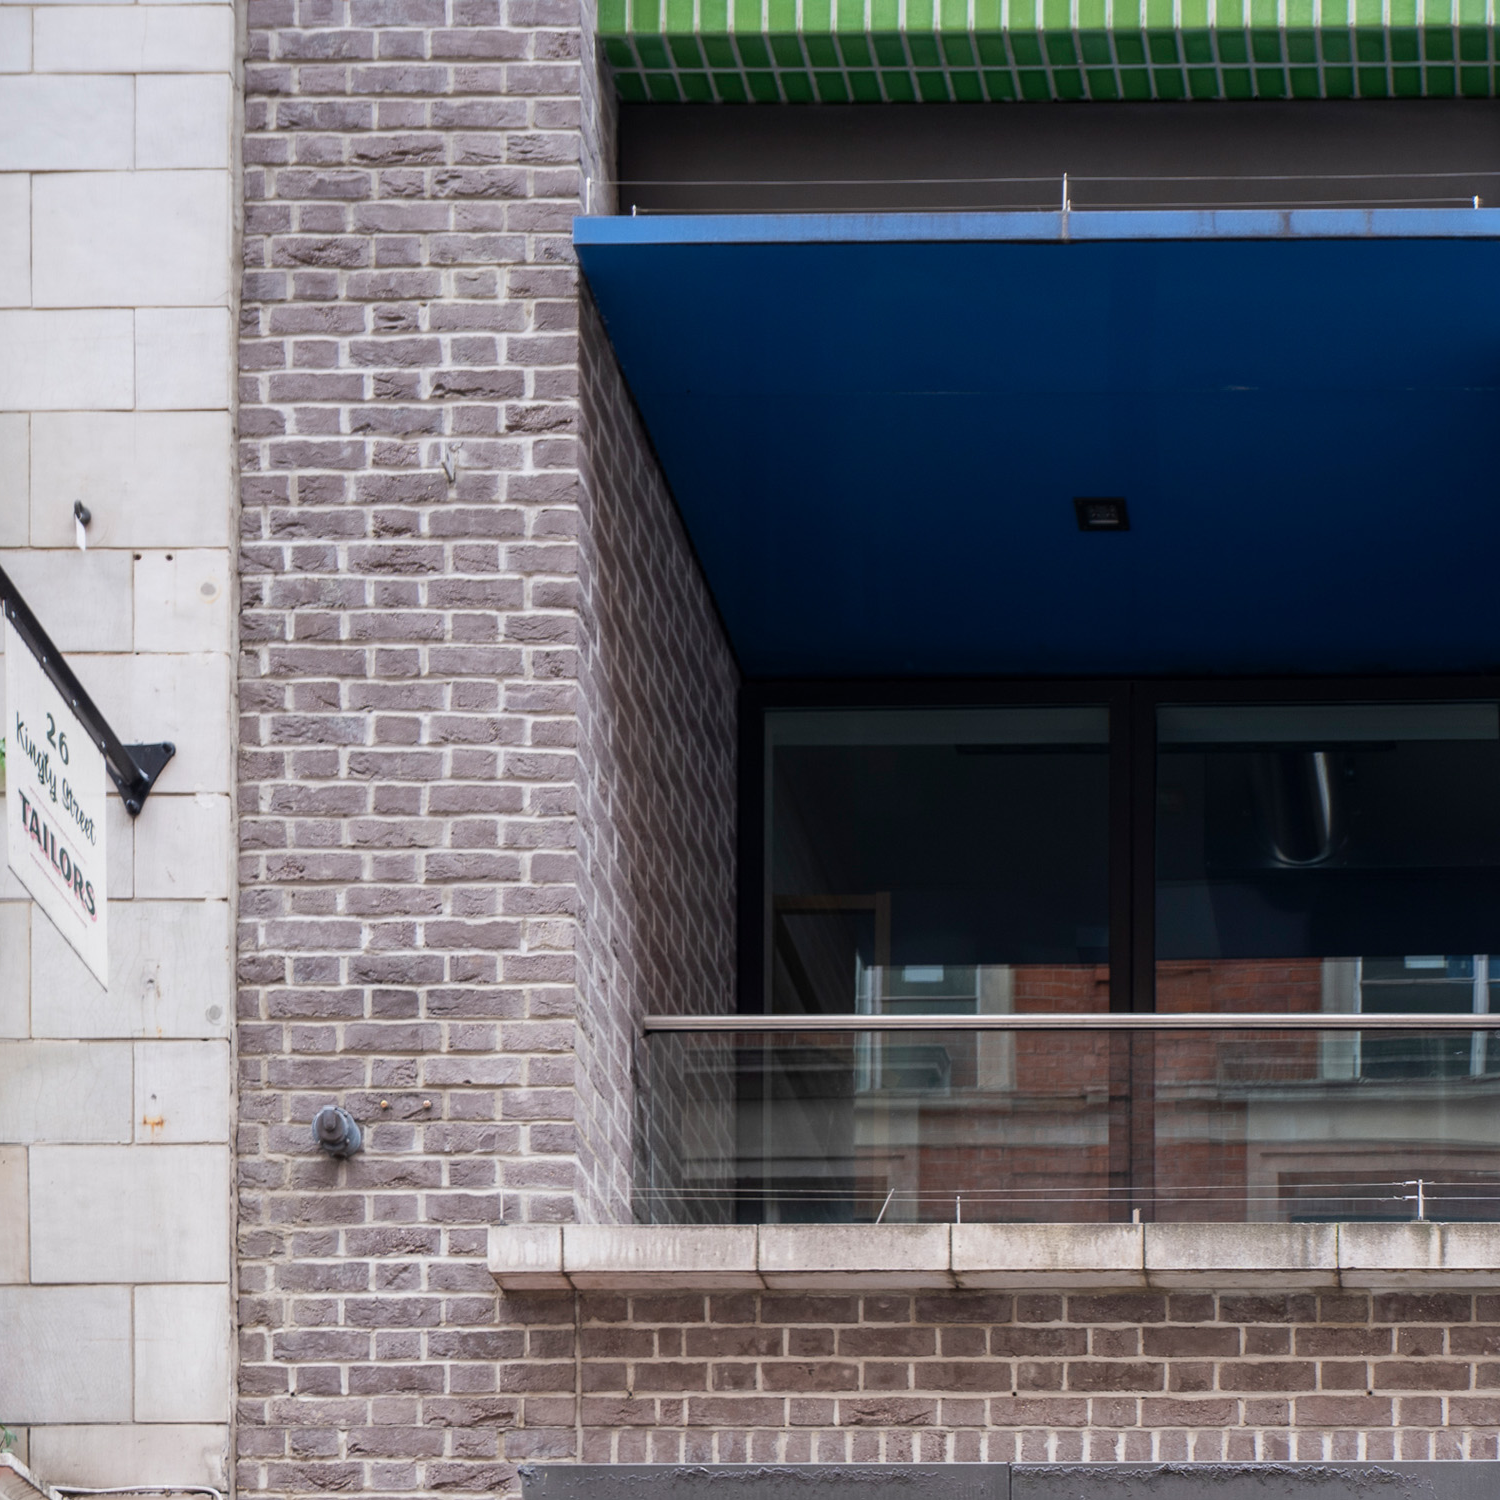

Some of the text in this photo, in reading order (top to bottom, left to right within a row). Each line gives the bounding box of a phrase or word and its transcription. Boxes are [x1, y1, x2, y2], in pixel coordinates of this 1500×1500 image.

[15, 710, 97, 847] Kingly Street
[46, 712, 69, 766] 26
[18, 788, 98, 923] TAILORS
